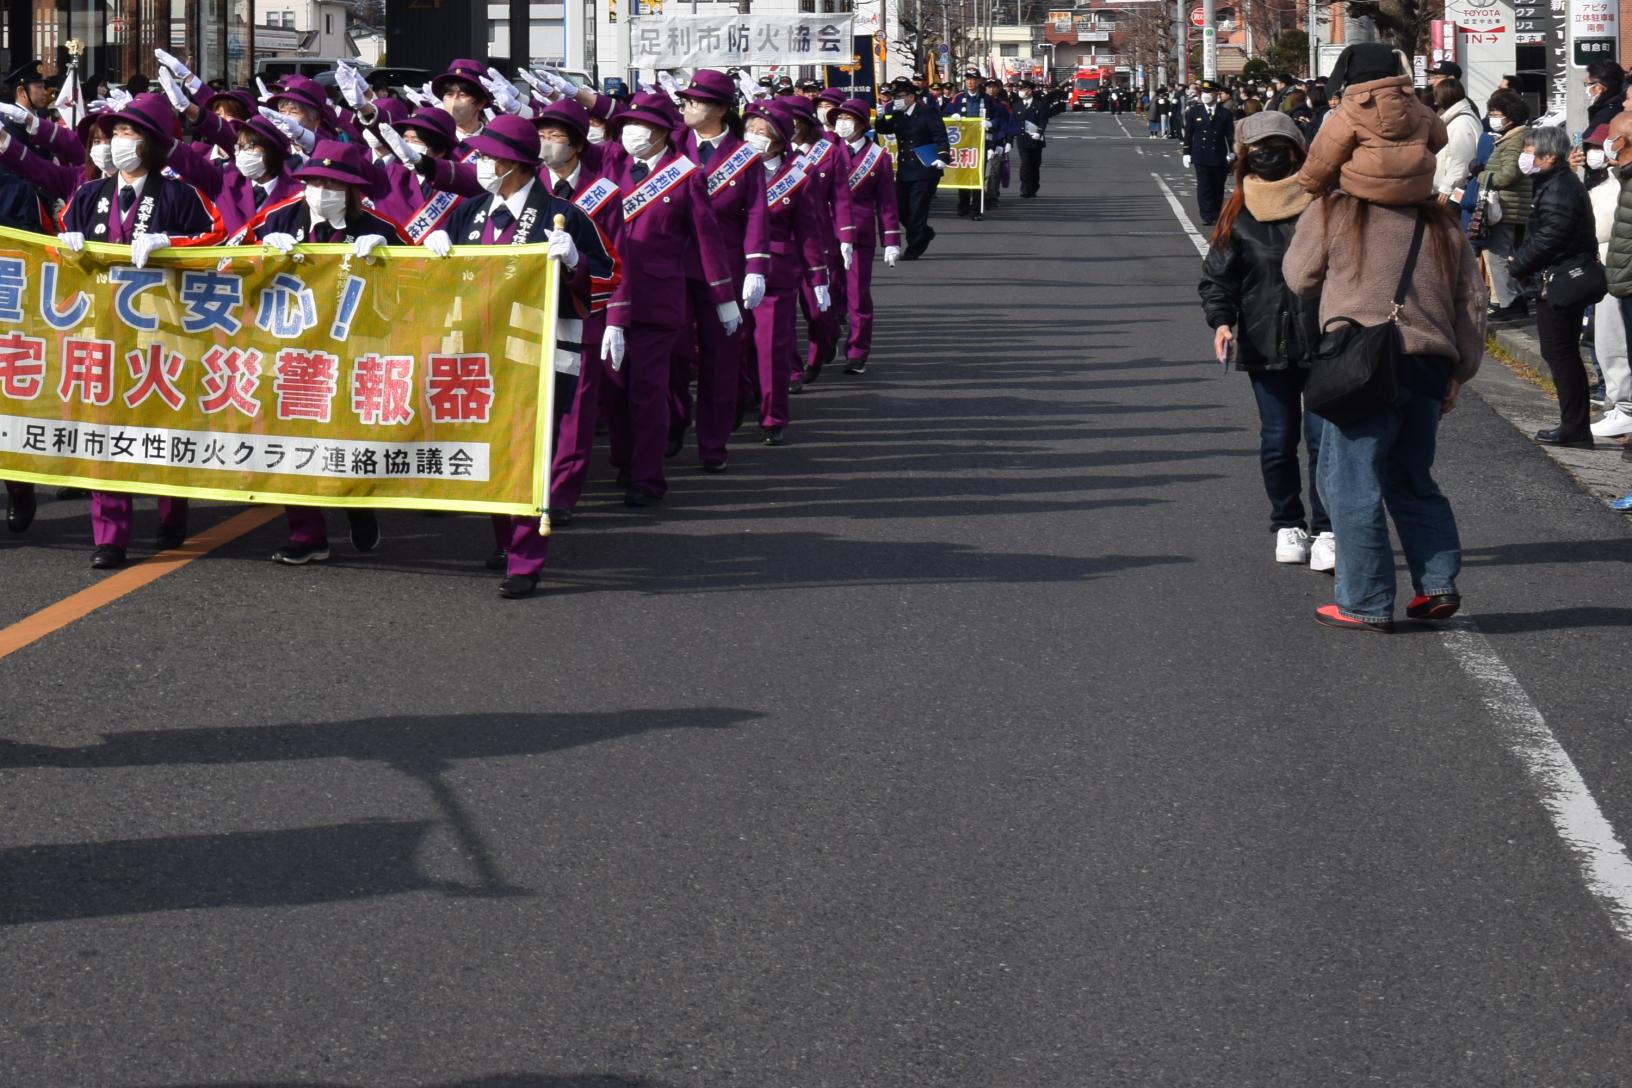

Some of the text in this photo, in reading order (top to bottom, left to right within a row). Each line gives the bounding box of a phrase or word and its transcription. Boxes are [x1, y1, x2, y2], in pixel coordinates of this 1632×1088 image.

[639, 23, 841, 56] 足利市防火協会
[1465, 34, 1483, 44] IN
[623, 166, 681, 215] 足利市女性
